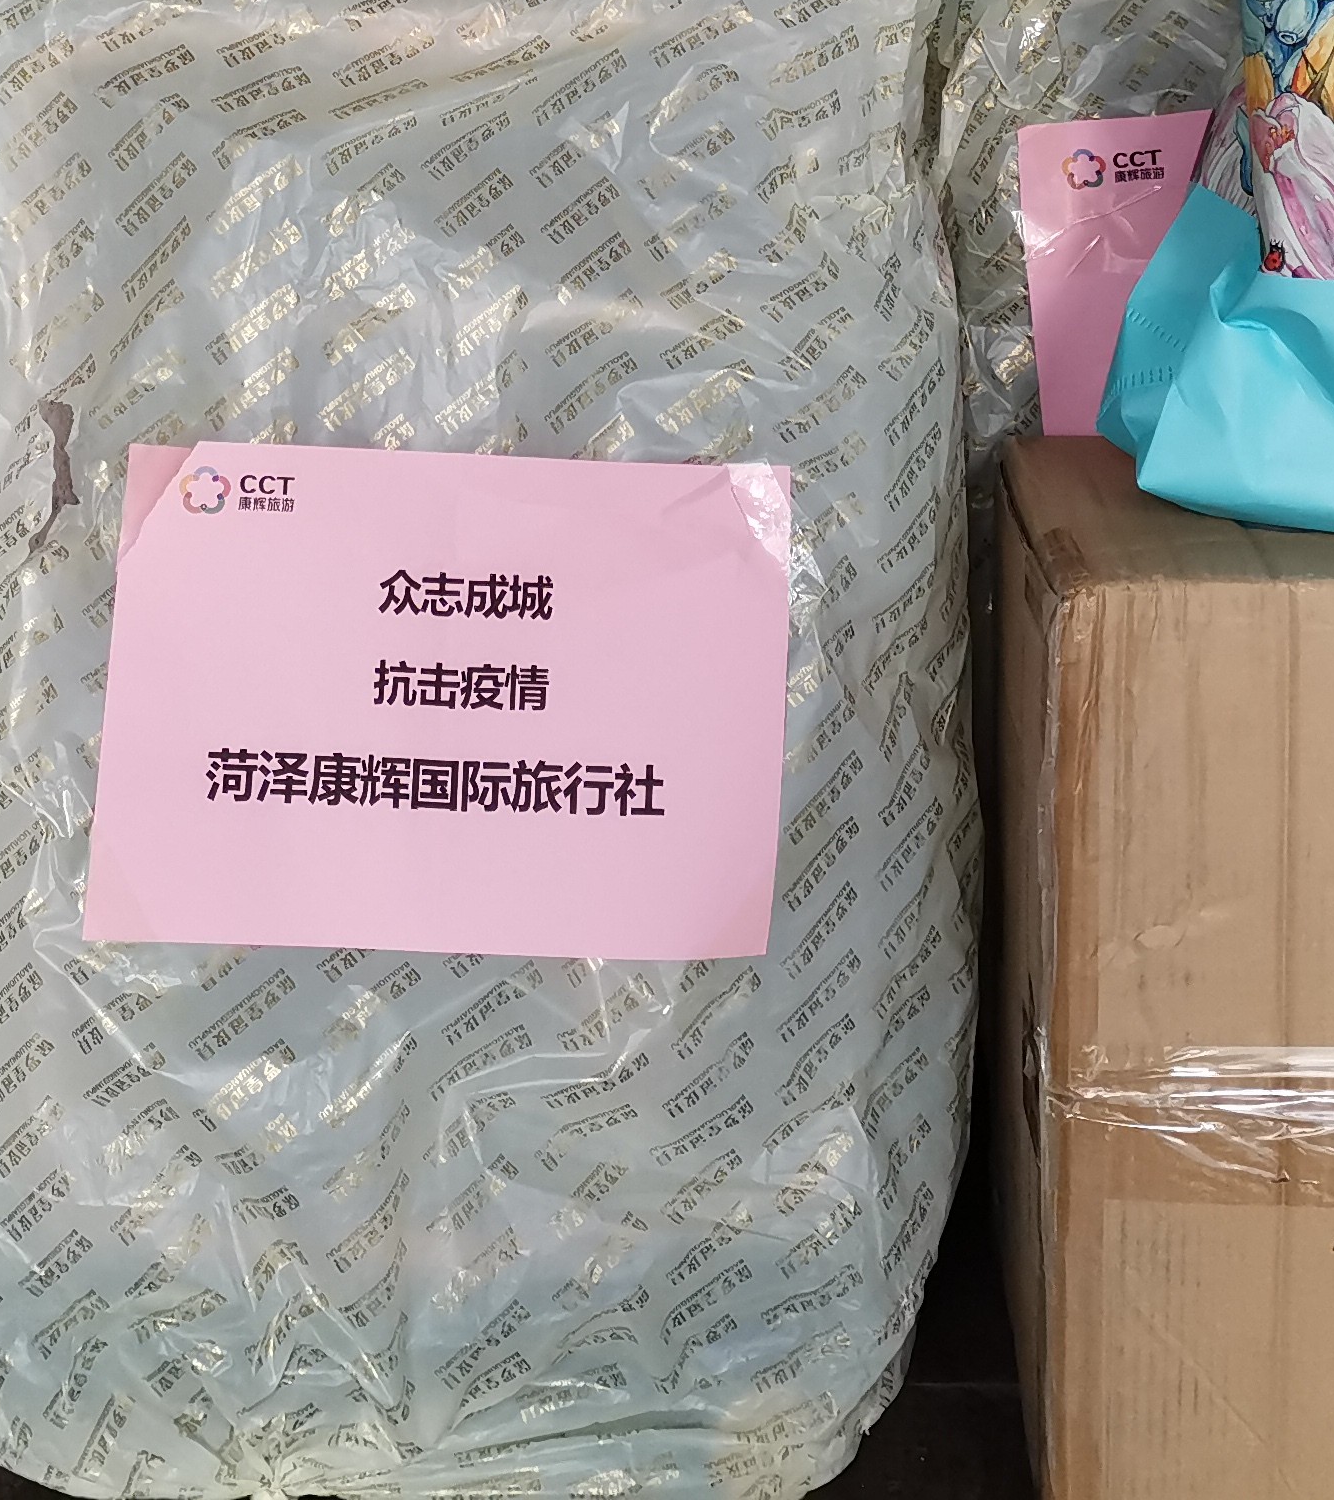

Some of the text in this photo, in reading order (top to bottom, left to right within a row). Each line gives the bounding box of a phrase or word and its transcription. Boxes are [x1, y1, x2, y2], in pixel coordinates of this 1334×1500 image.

[1113, 149, 1162, 169] CCT
[1114, 166, 1165, 183] 康辉旅游
[239, 474, 295, 495] CCT
[238, 495, 295, 513] 康辉旅游
[378, 570, 555, 620] 众志成城
[373, 660, 550, 712] 抗击疫情
[205, 749, 665, 817] 菏泽康辉国际旅行社
